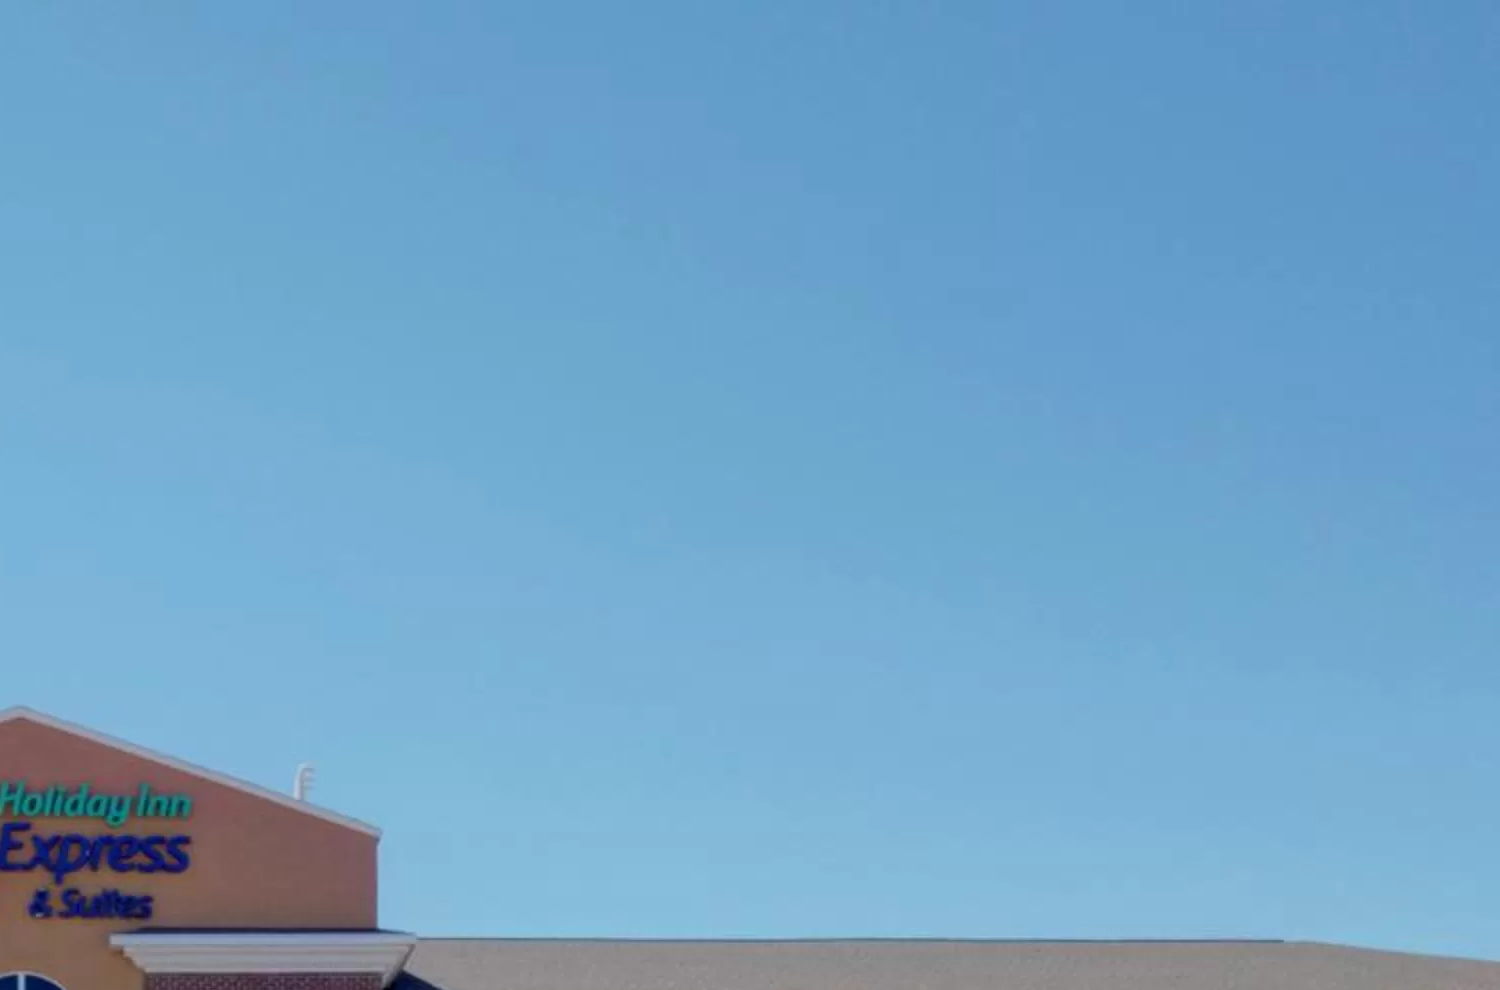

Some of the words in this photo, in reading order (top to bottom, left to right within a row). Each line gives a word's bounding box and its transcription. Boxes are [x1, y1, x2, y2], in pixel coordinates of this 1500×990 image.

[136, 783, 191, 817] Inn
[29, 890, 52, 917] &
[59, 889, 152, 918] Suites
